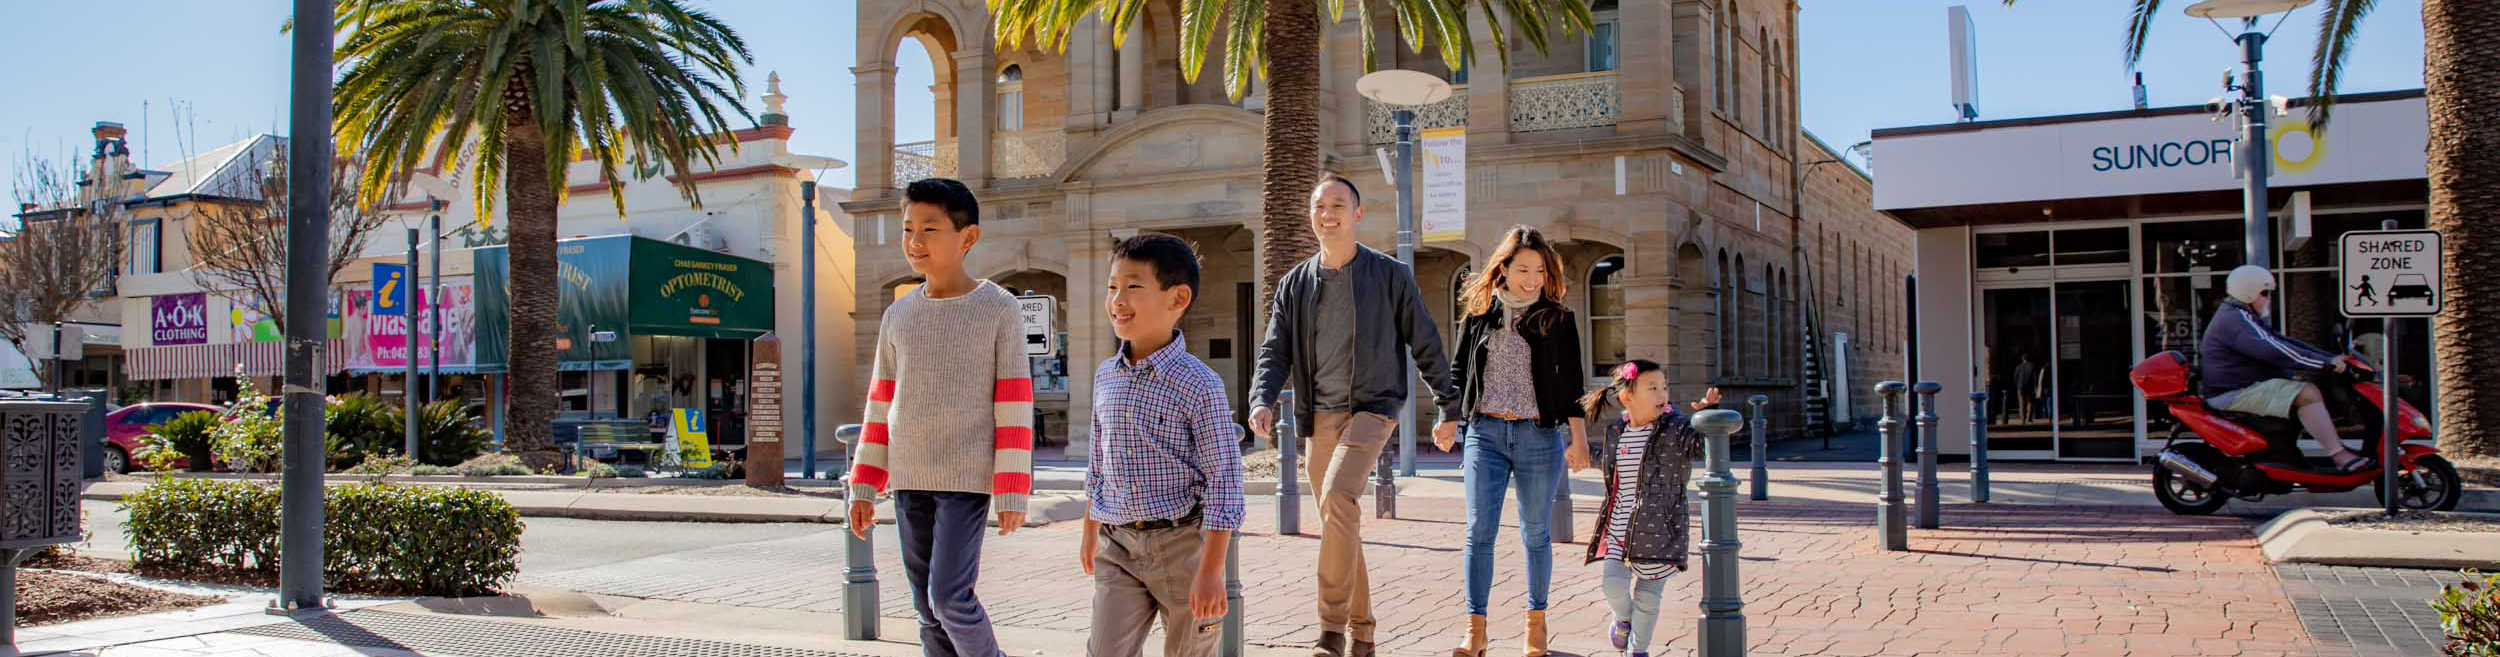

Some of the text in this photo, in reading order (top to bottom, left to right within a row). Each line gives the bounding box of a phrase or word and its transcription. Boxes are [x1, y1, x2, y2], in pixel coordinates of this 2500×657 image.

[2092, 139, 2240, 171] SUNCOR
[2359, 240, 2425, 253] SHARED
[2371, 257, 2412, 270] ZONE
[660, 272, 744, 302] OPTOMETRIST
[1021, 302, 1043, 312] ARED
[155, 327, 206, 341] CLOTHING
